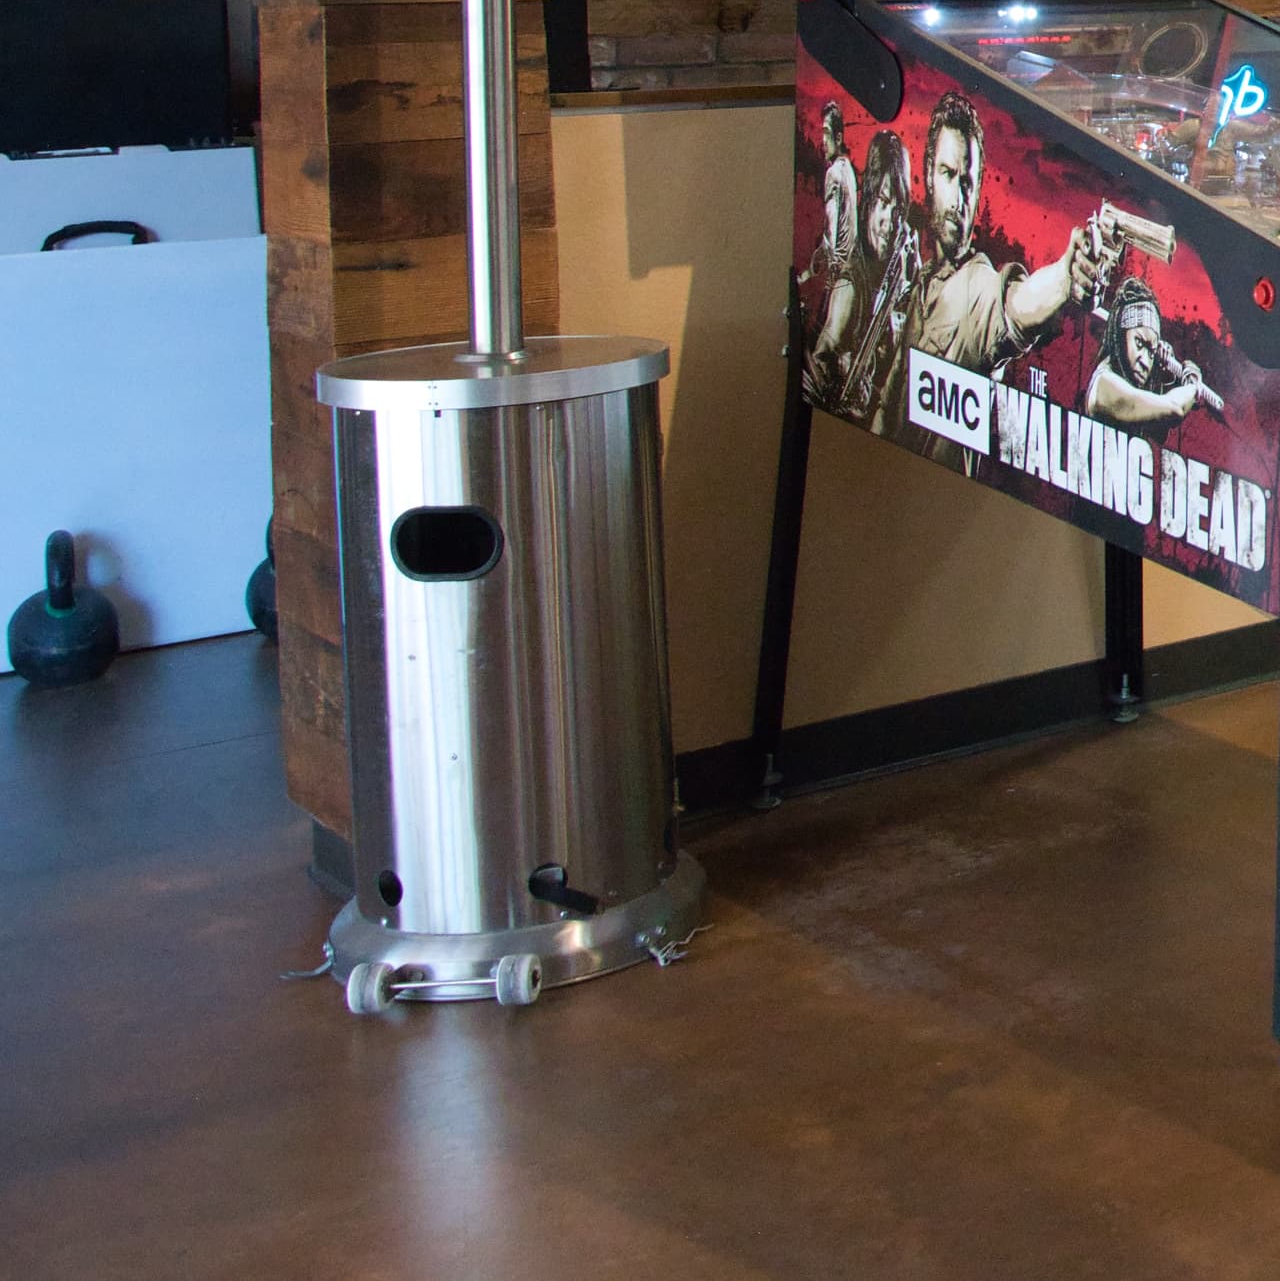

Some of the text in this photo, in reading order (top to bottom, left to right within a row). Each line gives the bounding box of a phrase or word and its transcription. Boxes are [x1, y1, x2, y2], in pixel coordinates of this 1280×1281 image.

[1029, 365, 1048, 399] THE
[994, 382, 1267, 572] WALKING DEAD
